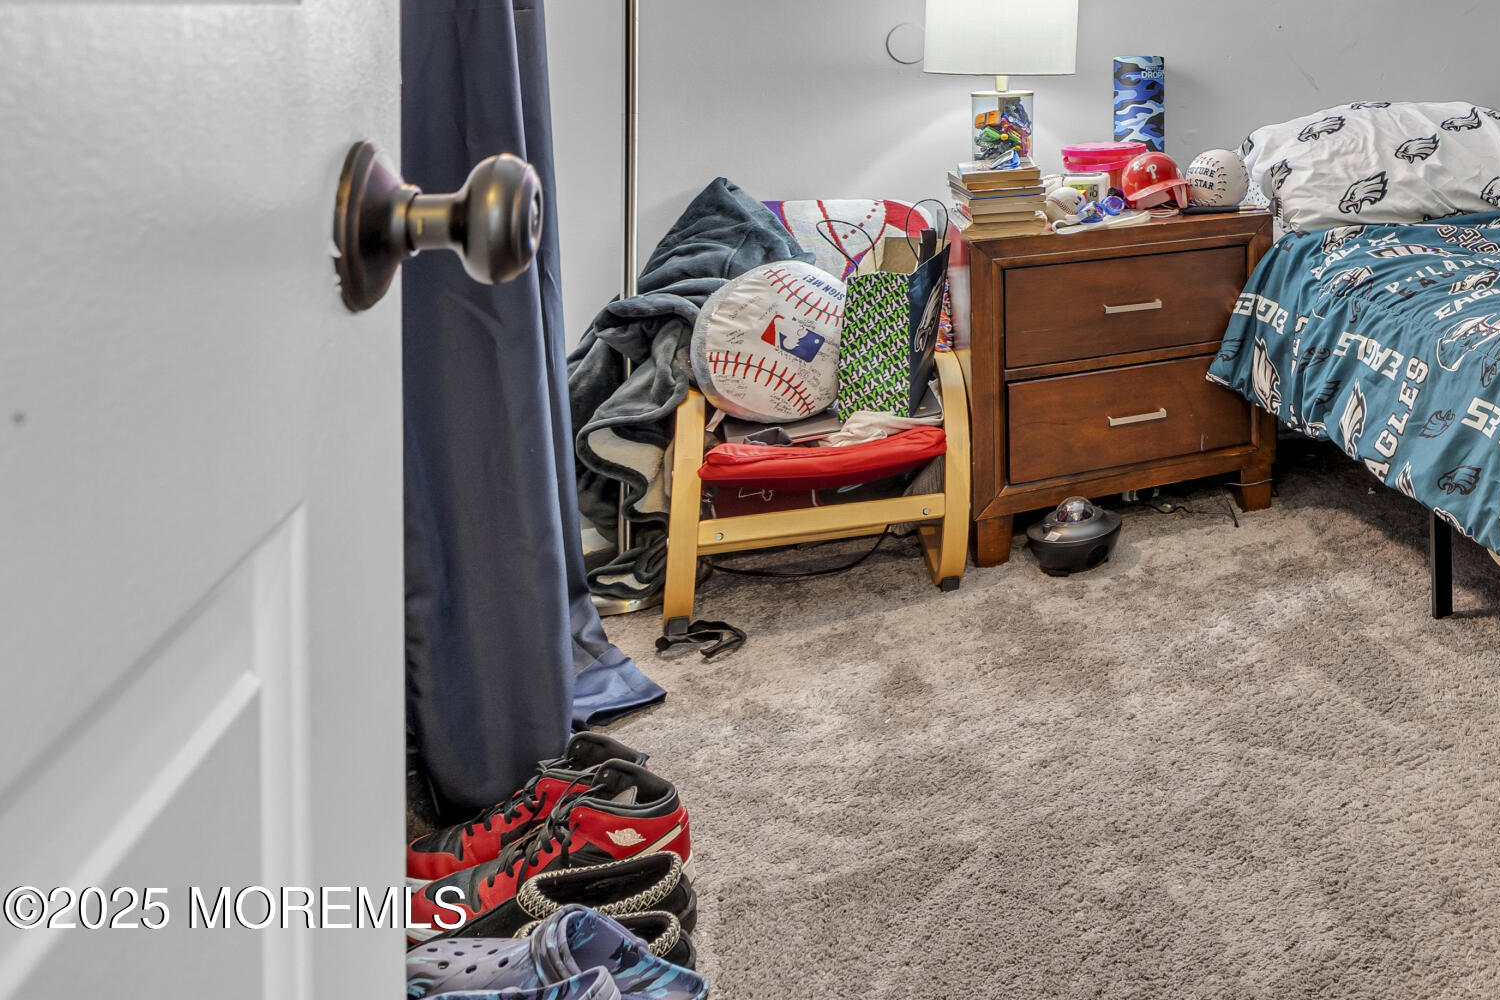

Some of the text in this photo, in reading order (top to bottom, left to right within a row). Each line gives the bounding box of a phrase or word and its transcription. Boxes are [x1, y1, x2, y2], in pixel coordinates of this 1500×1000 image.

[1194, 178, 1215, 190] STAR
[823, 284, 846, 301] SIGN
[1364, 355, 1430, 486] AGLES
